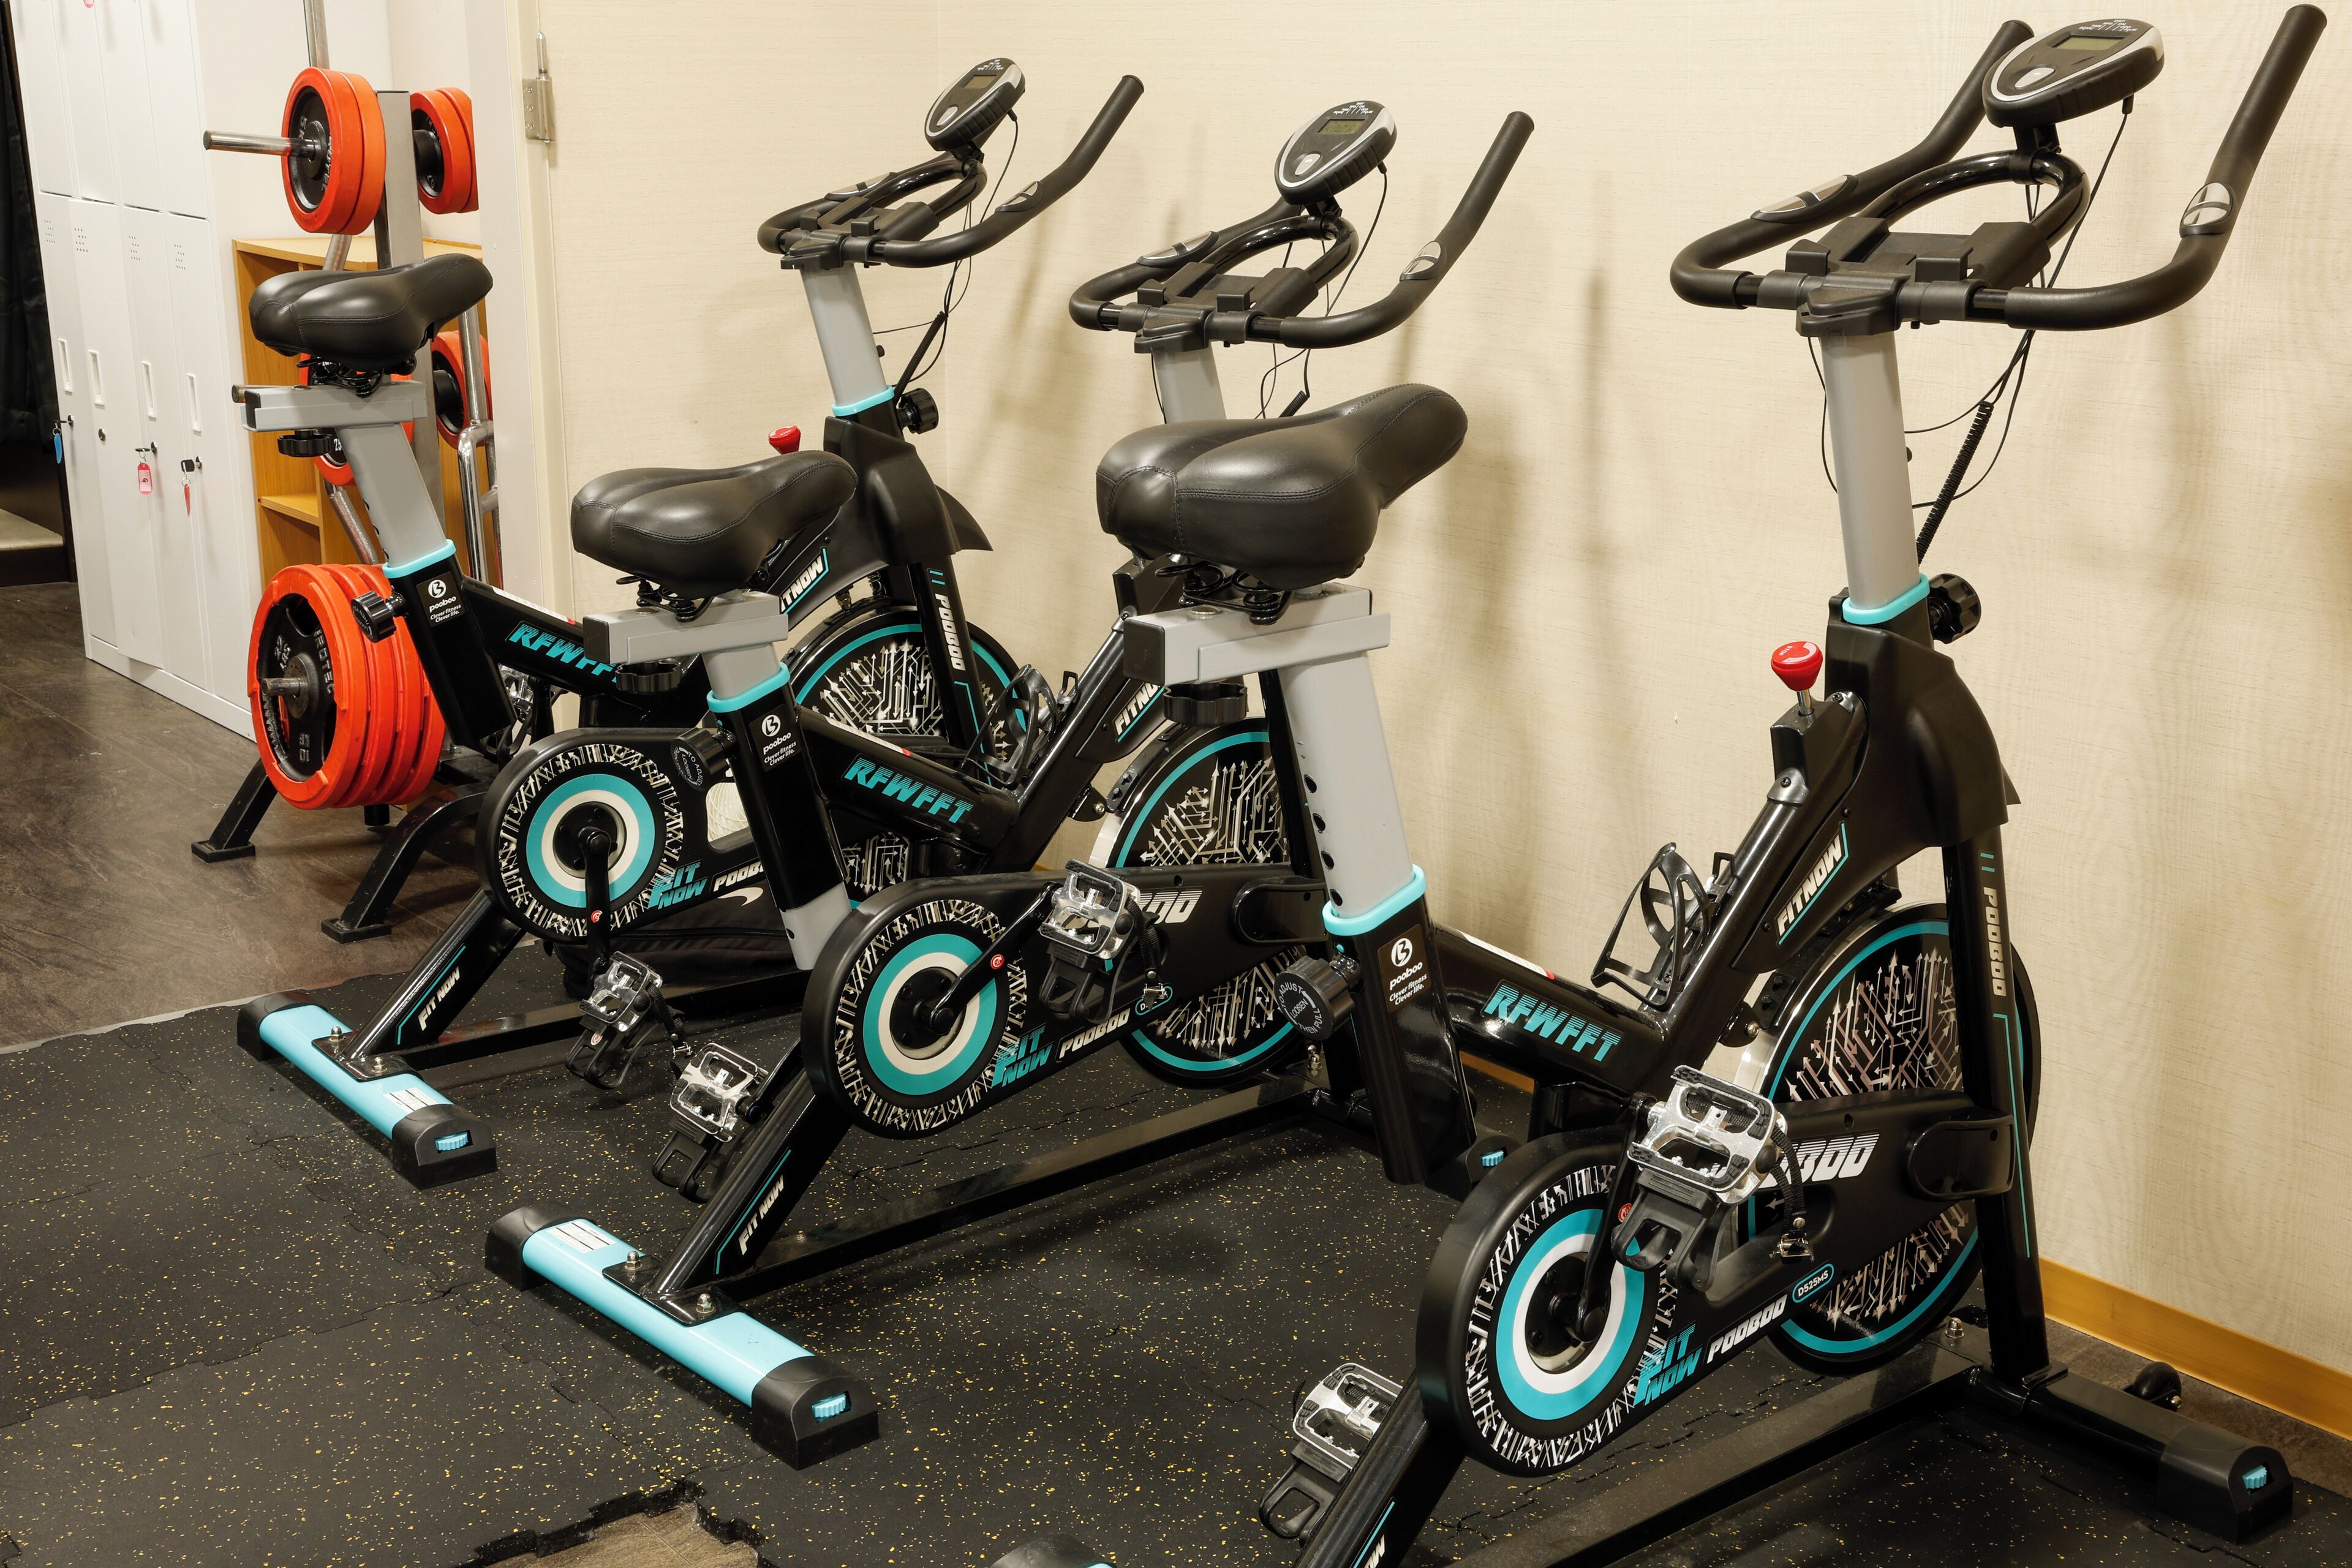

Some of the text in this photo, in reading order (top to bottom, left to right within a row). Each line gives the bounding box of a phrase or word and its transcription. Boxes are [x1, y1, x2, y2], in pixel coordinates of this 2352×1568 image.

[429, 596, 456, 613] pooboo
[430, 604, 461, 620] Clever fitness
[435, 610, 460, 623] Clever life.
[935, 593, 965, 671] POOBOO
[509, 624, 617, 684] RFWFF
[1115, 682, 1160, 736] FITNO
[687, 751, 696, 763] TO
[763, 732, 791, 755] pooboo
[764, 741, 797, 764] Clever fitness
[769, 749, 795, 766] Clever life.
[681, 753, 693, 780] LOOSEN
[844, 757, 974, 824] RFWFFT
[713, 861, 764, 892] POOB
[1777, 834, 1842, 937] FITNOW
[657, 878, 707, 910] NOW
[1983, 886, 2007, 997] POOBOO
[1389, 962, 1423, 991] pooboo
[1389, 974, 1427, 1001] Clever fitness
[417, 966, 460, 1031] FIT NOW
[1279, 982, 1303, 1009] TO ADJUST
[1289, 998, 1308, 1019] LOOSEN
[1395, 983, 1425, 1005] Clever life.
[1058, 1008, 1131, 1060] POOBOO
[1297, 1008, 1323, 1034] THEN PULL
[1483, 984, 1623, 1062] RFWFFT
[1001, 1043, 1054, 1088] NOW
[738, 1174, 784, 1256] FIT NOW
[1797, 1270, 1829, 1297] D525MS
[1706, 1294, 1788, 1365] POOBOO
[1644, 1347, 1703, 1406] NOW
